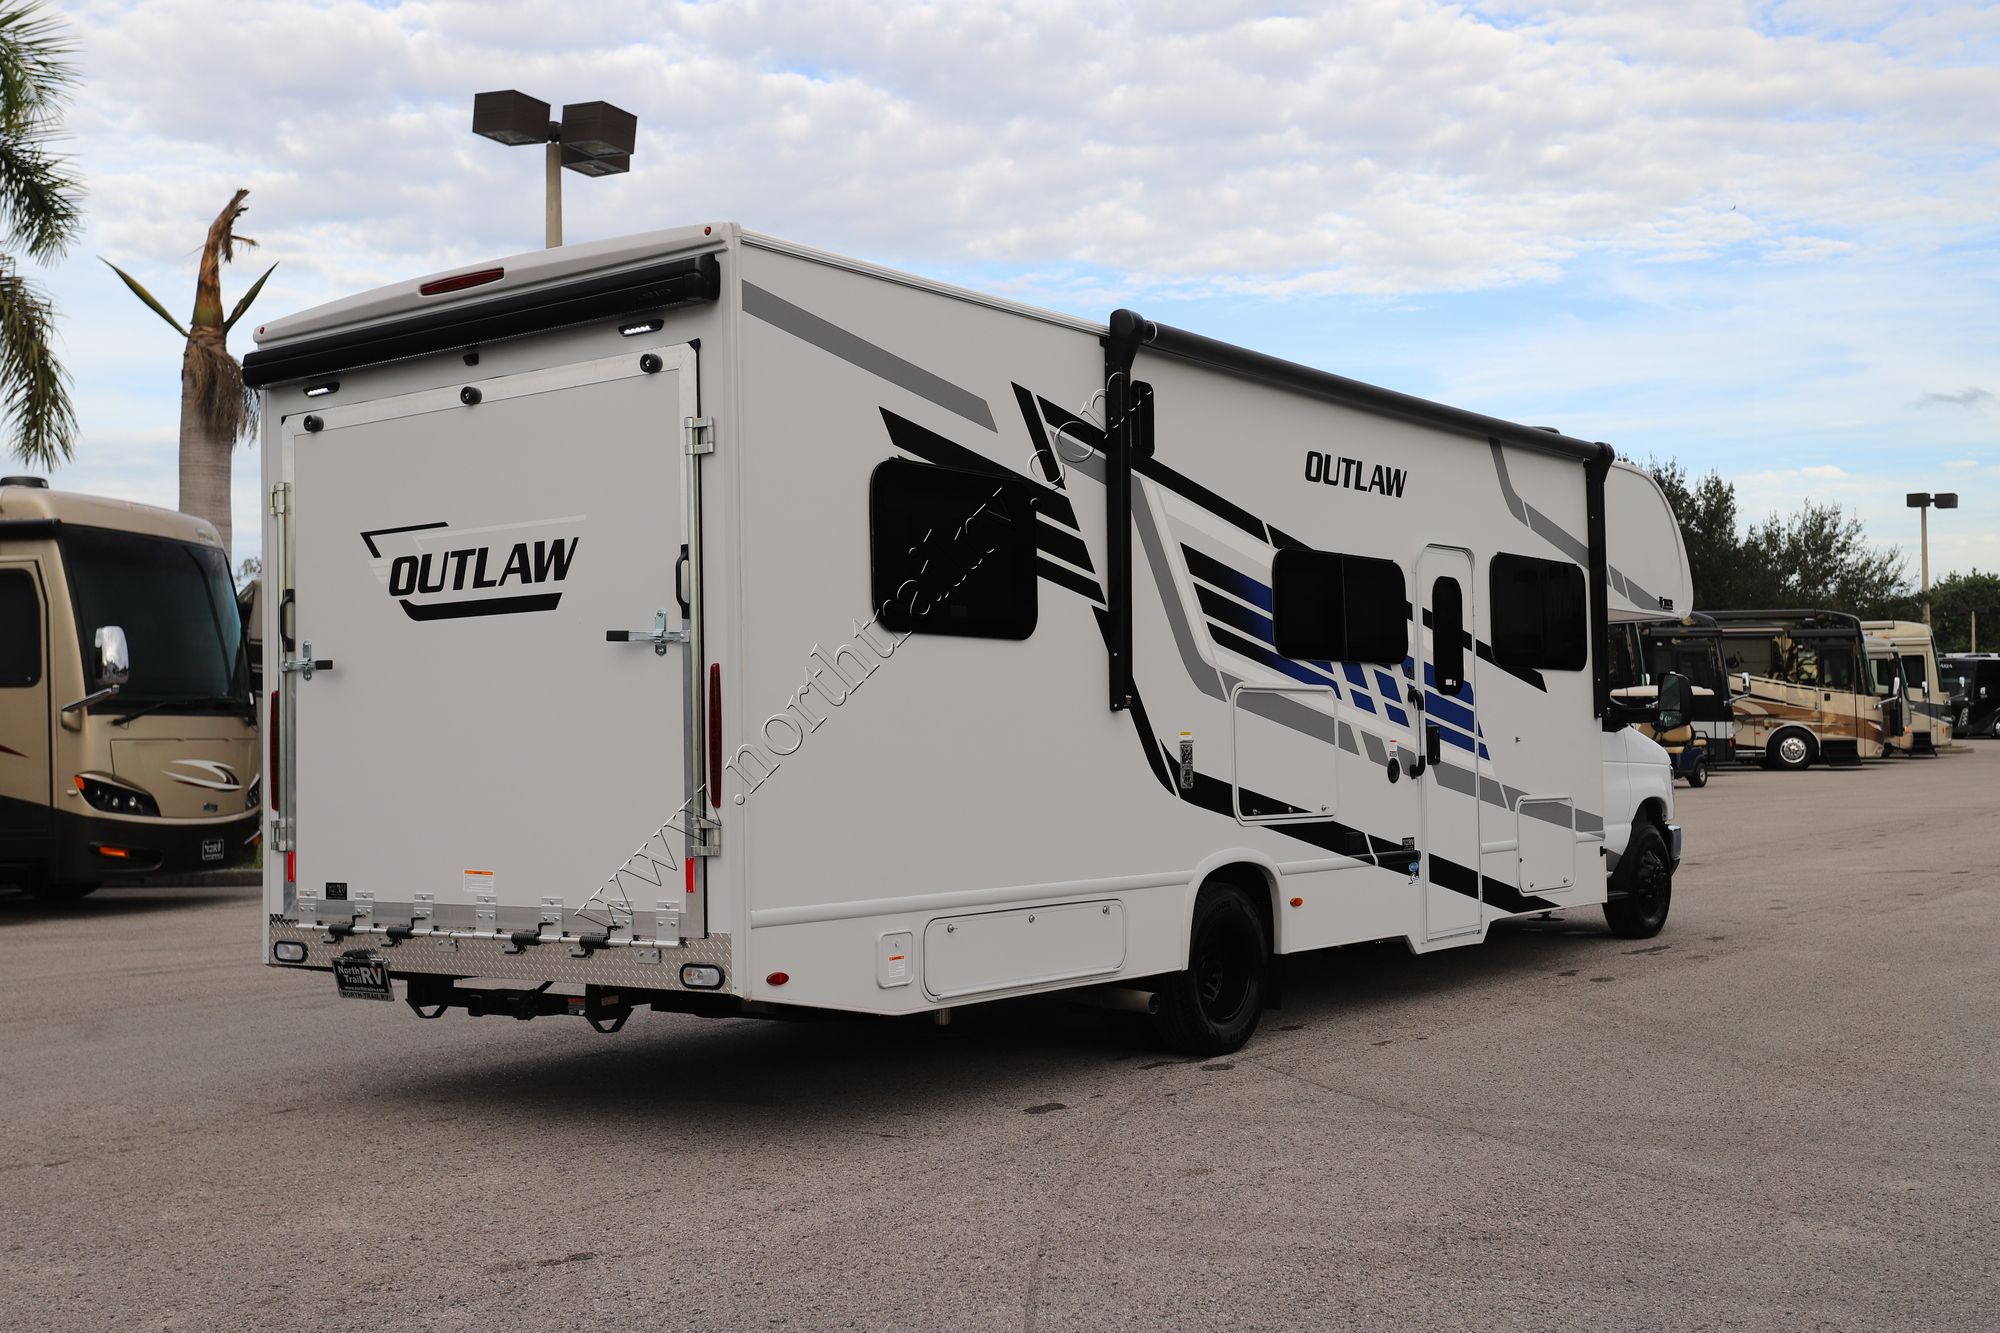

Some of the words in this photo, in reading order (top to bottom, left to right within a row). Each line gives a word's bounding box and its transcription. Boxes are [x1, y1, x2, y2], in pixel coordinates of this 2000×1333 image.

[1305, 451, 1407, 498] OUTLAW
[389, 537, 579, 596] OUTLAW
[337, 965, 360, 975] North
[343, 974, 362, 984] Trail
[360, 967, 381, 985] RV
